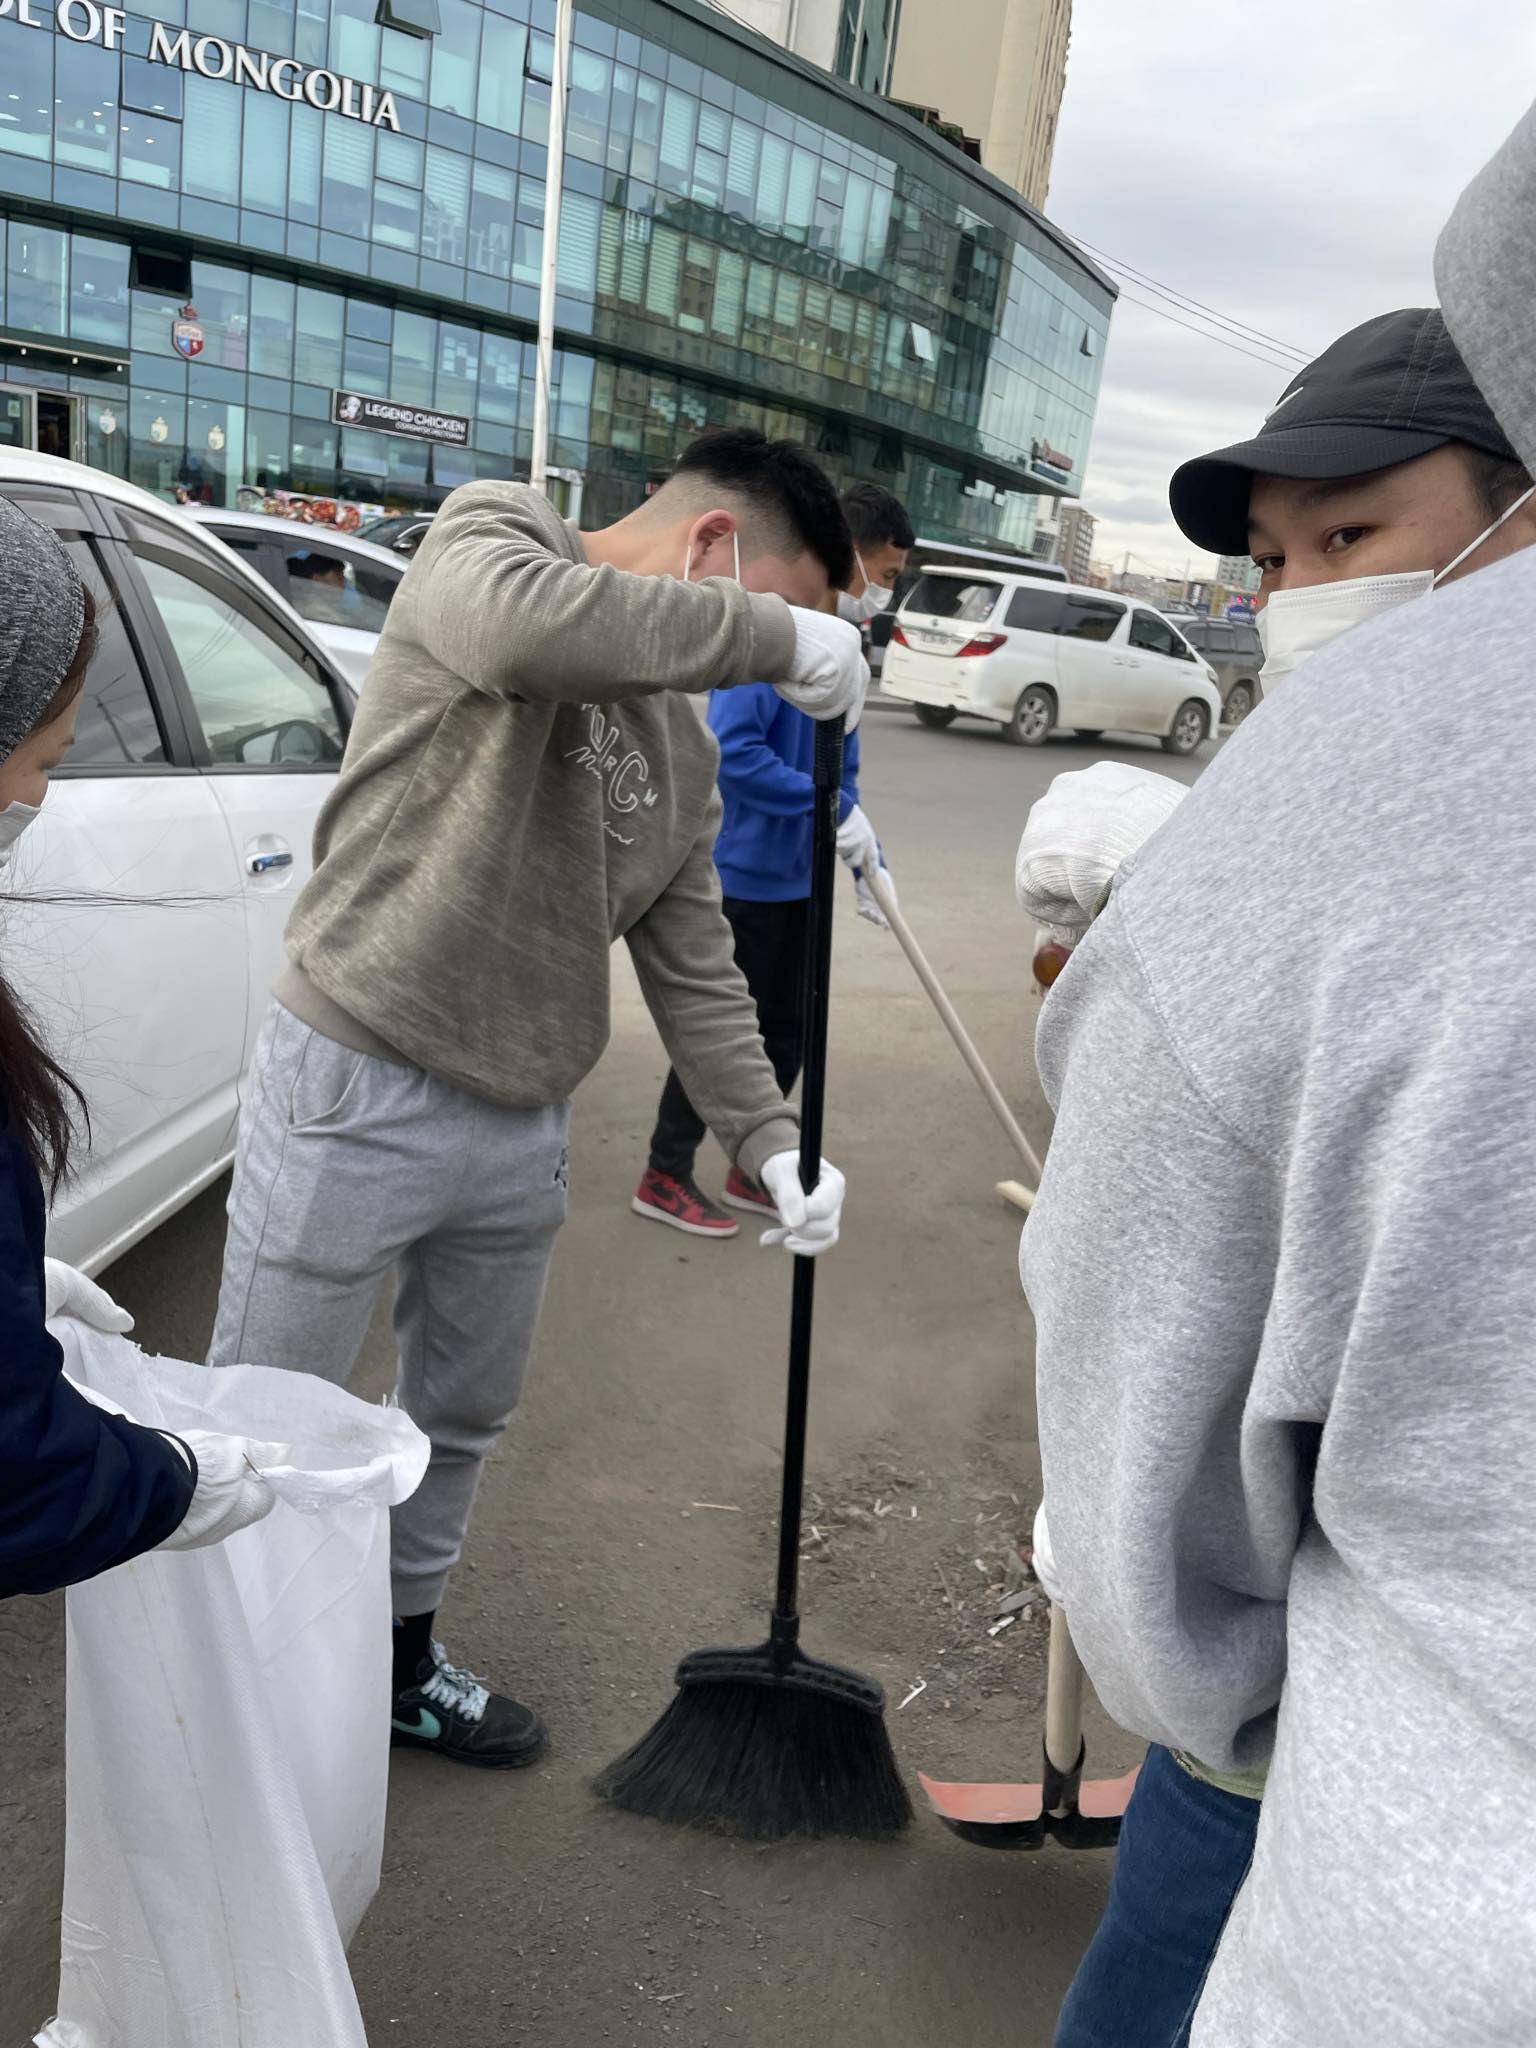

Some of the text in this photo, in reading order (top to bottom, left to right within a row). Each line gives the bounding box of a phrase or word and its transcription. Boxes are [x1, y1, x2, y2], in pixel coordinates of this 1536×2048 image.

[57, 0, 126, 49] OF
[149, 22, 401, 132] MONGOLIA
[365, 402, 414, 423] LEGEND
[413, 412, 466, 433] CHICKEN
